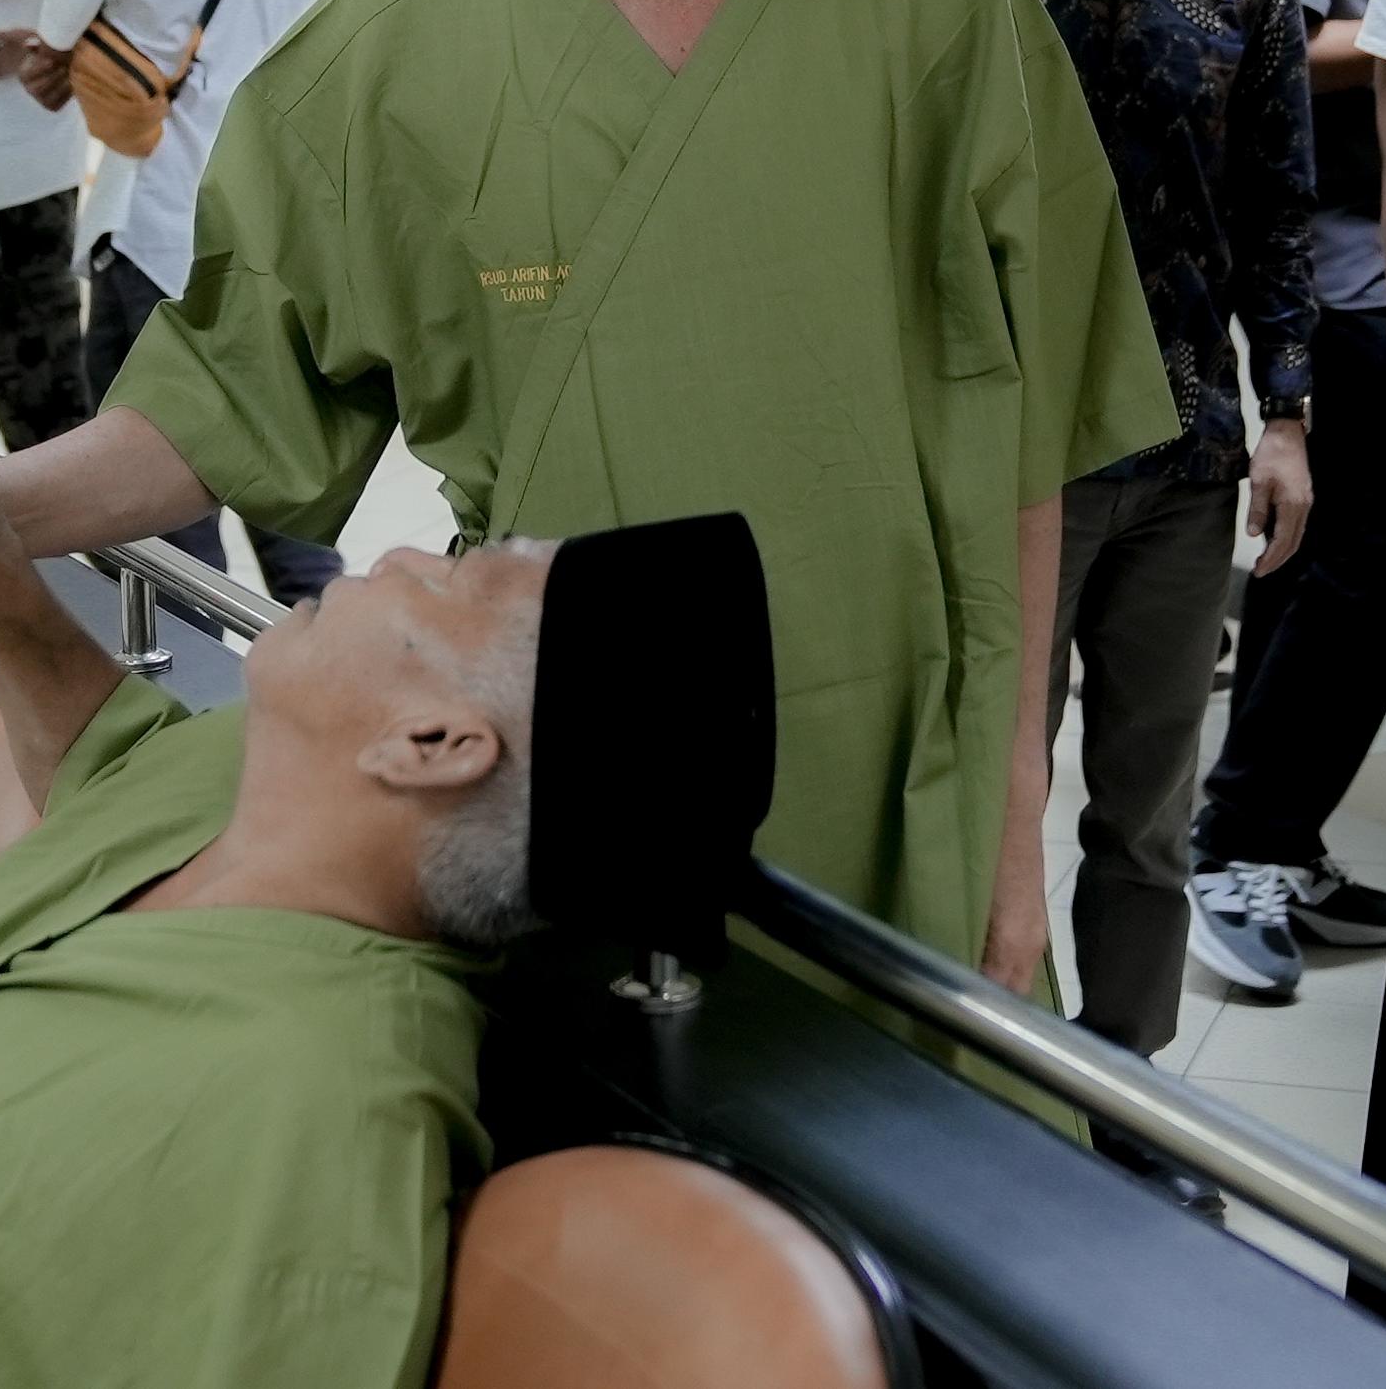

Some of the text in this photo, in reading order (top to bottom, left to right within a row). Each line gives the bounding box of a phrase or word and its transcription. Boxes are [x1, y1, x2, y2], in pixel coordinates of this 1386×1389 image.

[480, 270, 507, 287] RSUD
[512, 266, 551, 282] ARIFIN
[501, 286, 546, 302] TAHUN
